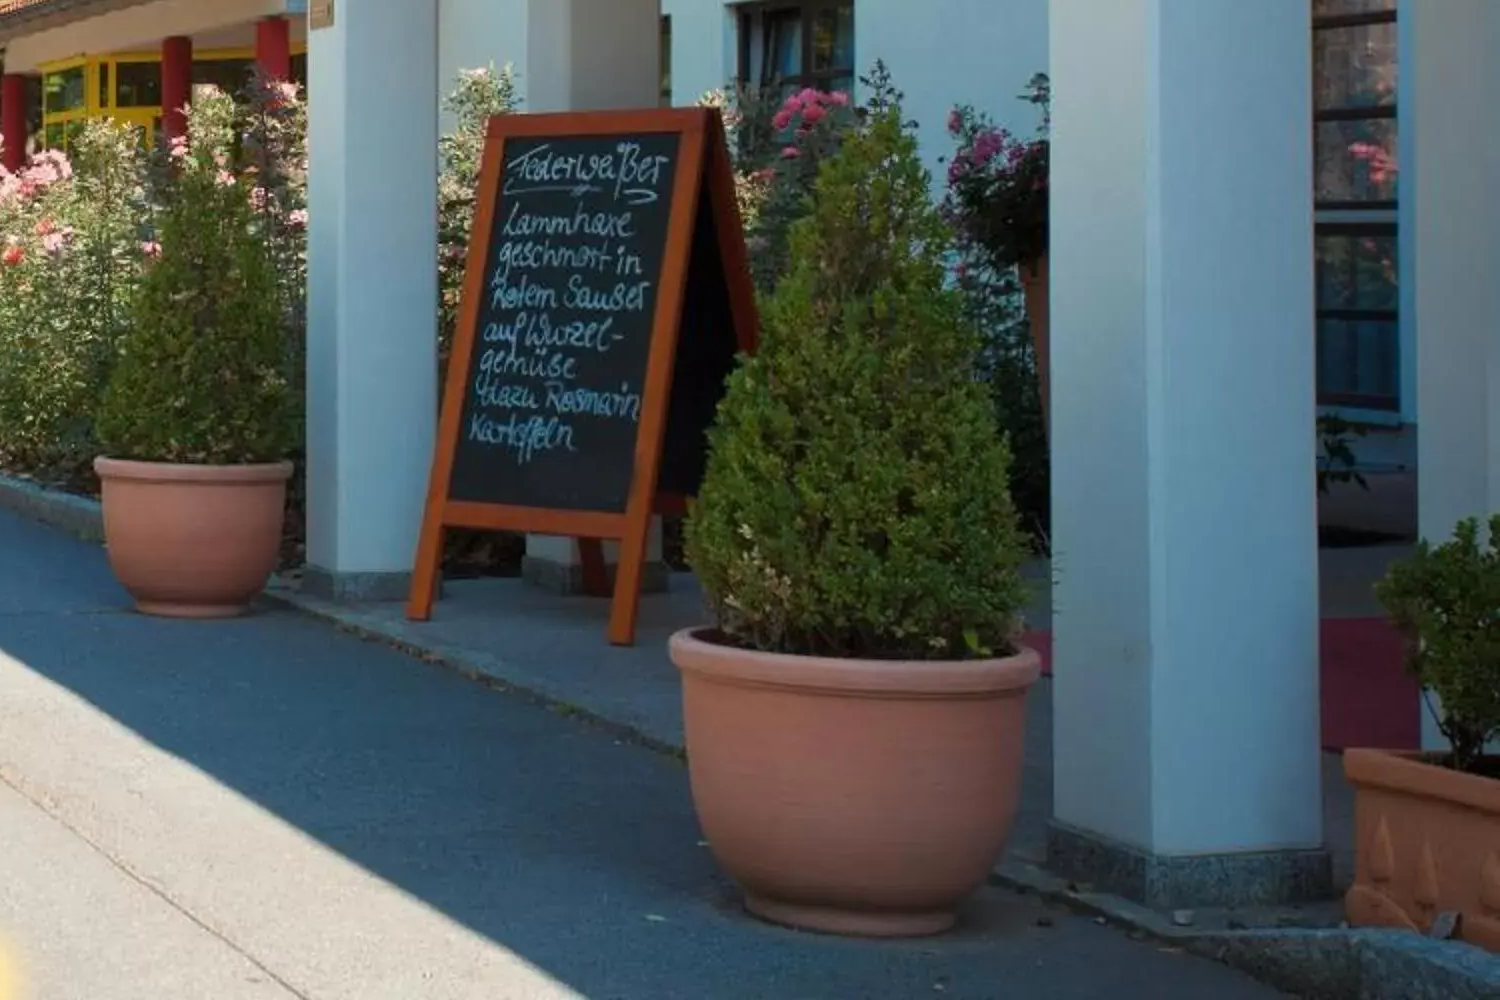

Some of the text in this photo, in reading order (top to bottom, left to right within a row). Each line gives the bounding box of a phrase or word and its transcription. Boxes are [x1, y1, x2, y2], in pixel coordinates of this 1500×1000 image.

[503, 201, 635, 237] Lammhaxe
[500, 240, 642, 277] geschmort in
[483, 311, 526, 356] auf
[468, 412, 578, 466] Kartoffeln
